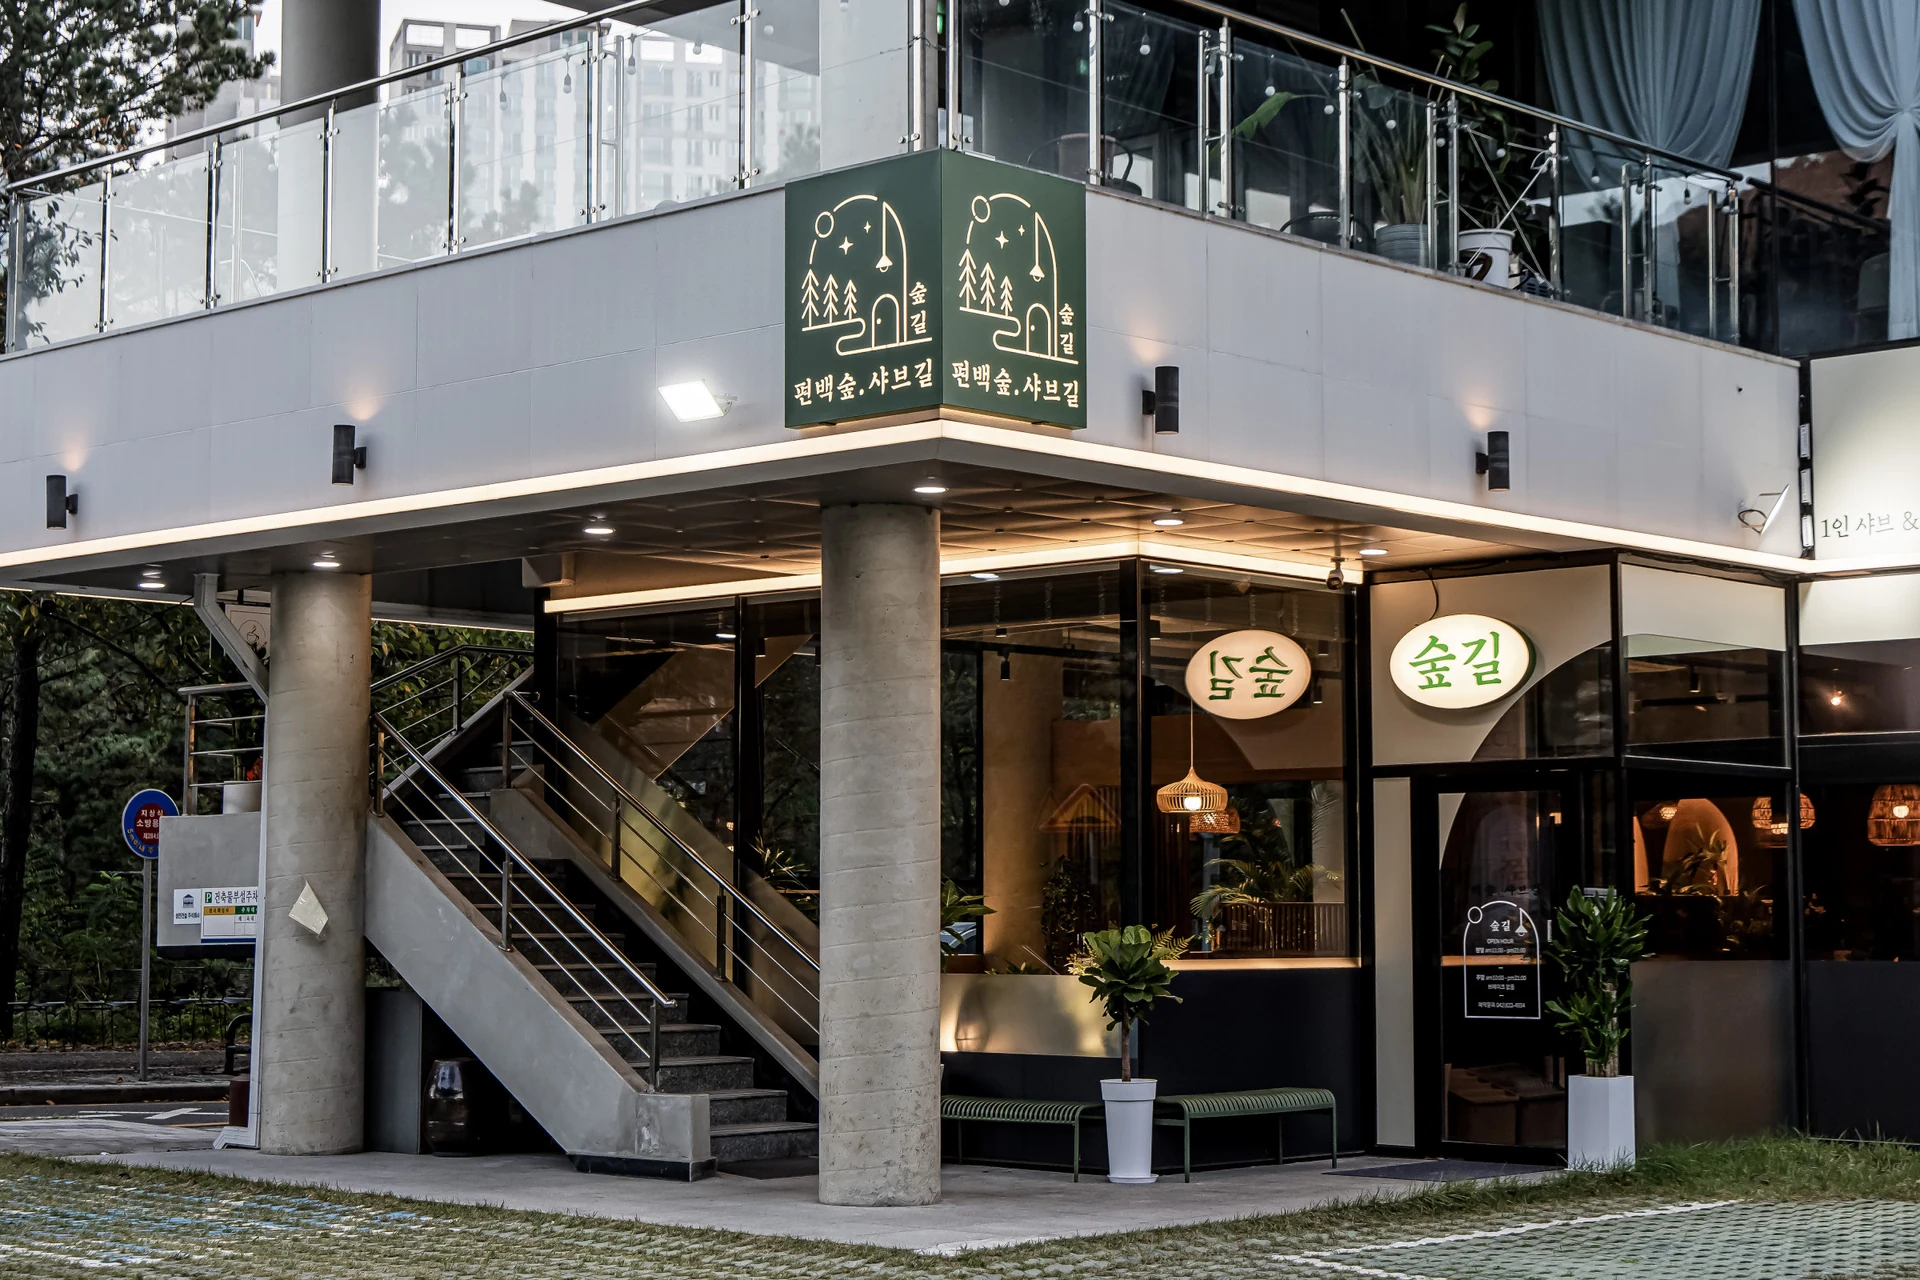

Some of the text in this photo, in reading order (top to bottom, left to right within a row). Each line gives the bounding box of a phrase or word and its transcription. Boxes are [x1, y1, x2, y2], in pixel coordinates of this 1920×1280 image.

[1821, 514, 1849, 538] 1인
[1856, 512, 1895, 536] 샤브
[1409, 631, 1502, 690] 숲길
[205, 892, 212, 903] P
[1490, 919, 1511, 932] 숲길
